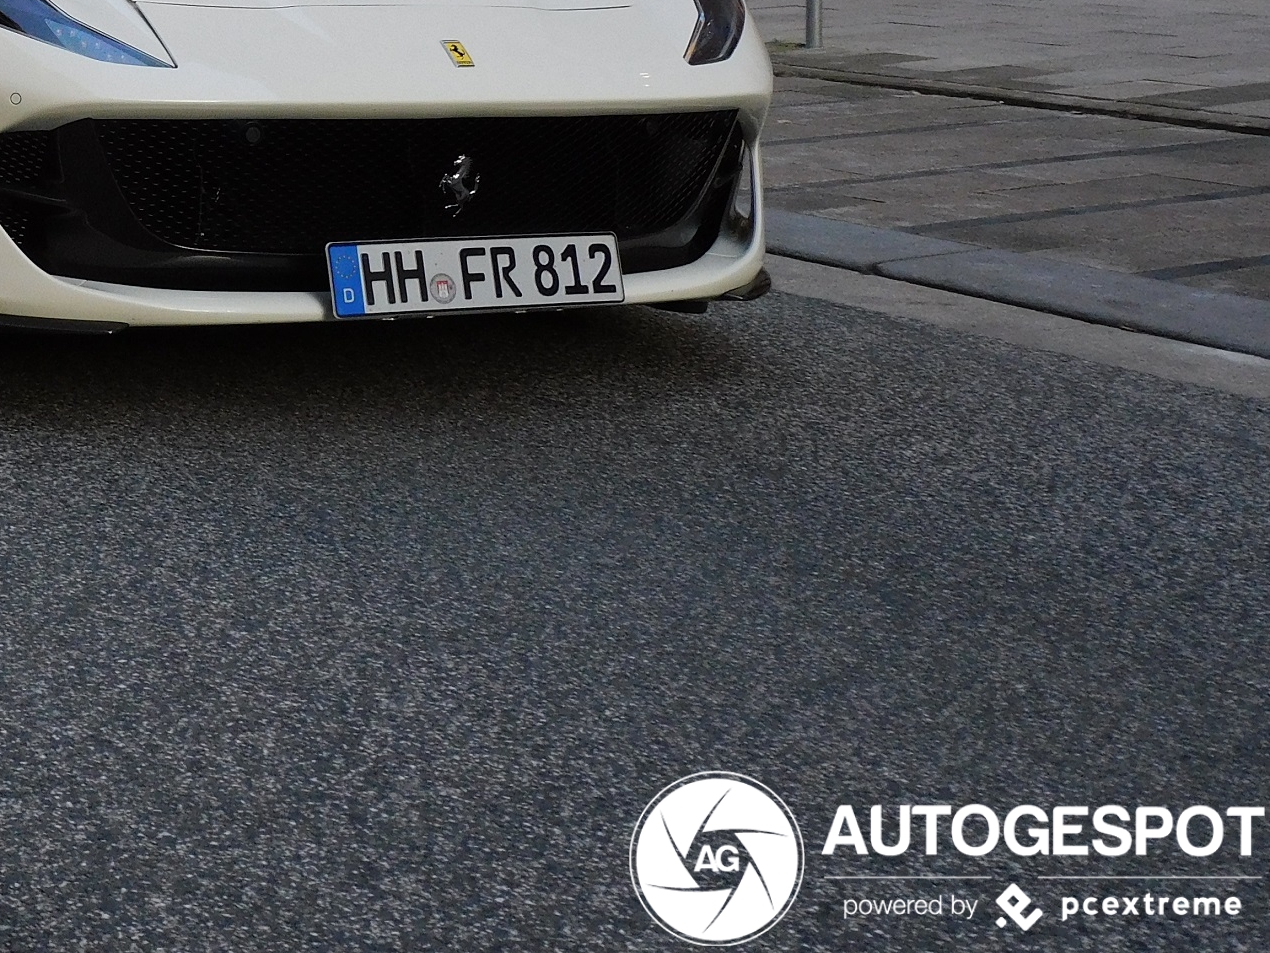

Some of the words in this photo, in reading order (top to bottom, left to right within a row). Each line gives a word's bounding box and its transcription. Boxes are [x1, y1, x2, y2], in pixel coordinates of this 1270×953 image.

[343, 288, 355, 303] D
[360, 250, 429, 306] HH
[459, 246, 523, 300] FR
[532, 243, 617, 297] 812
